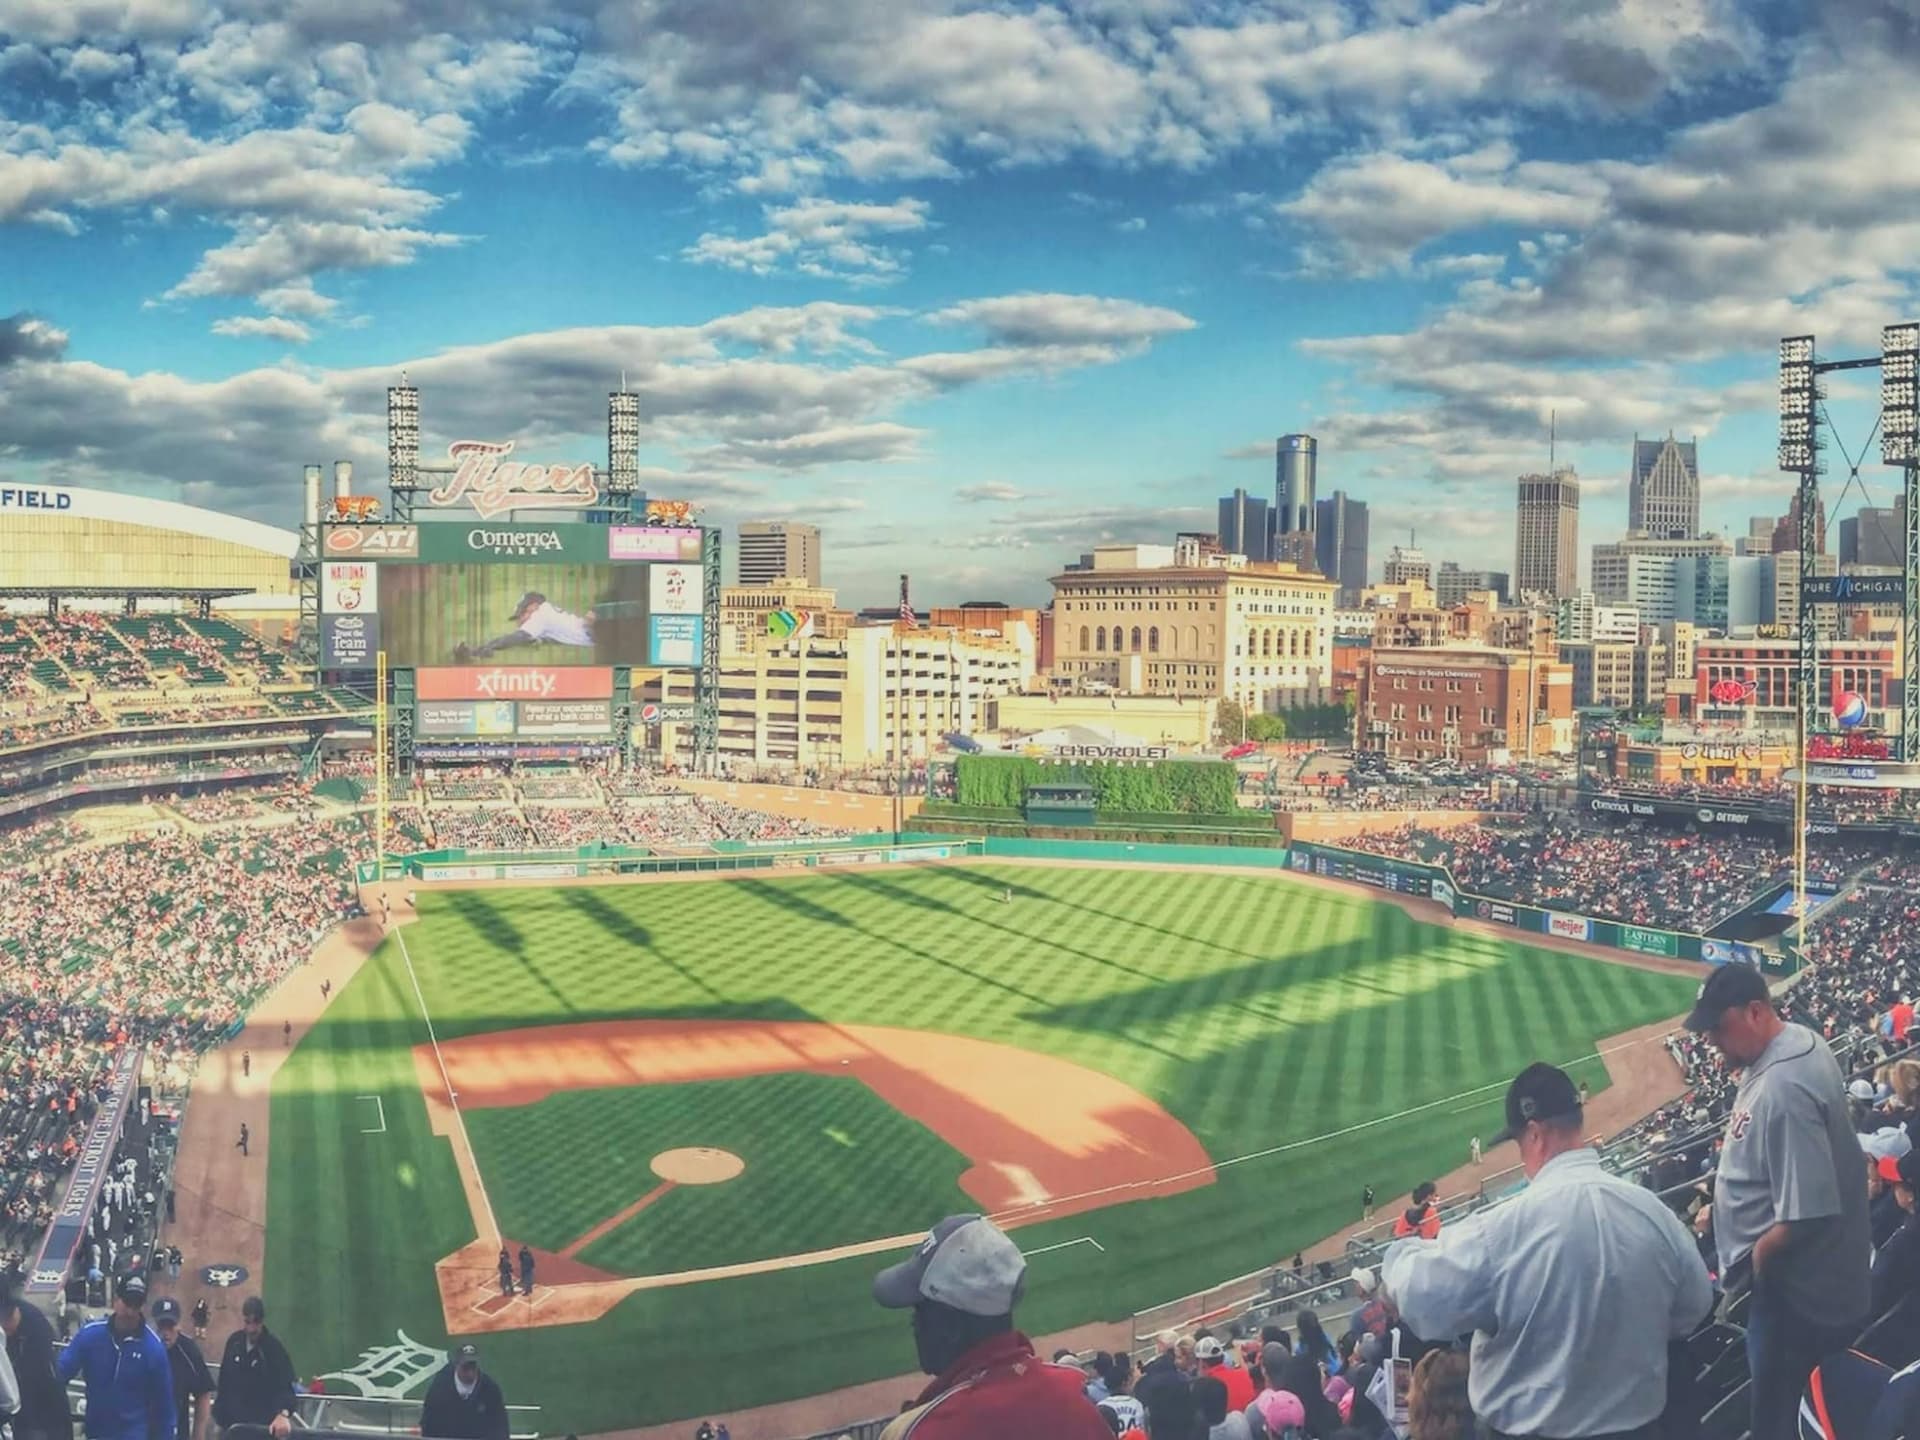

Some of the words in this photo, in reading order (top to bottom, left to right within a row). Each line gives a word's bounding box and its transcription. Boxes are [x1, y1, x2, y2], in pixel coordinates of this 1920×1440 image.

[429, 440, 598, 520] Tigers
[2, 489, 71, 509] FIELD
[362, 531, 418, 547] ATI
[1804, 583, 1831, 593] PURE
[1836, 576, 1903, 597] MICHIGAN
[332, 636, 366, 649] Team
[661, 706, 694, 719] pepsi
[1055, 745, 1169, 759] CHEVROLET
[1632, 804, 1655, 815] Bank
[1716, 812, 1750, 824] DETROIT
[1552, 919, 1585, 935] meijer
[1624, 927, 1667, 945] EASTERN
[79, 1131, 111, 1173] DETROIT
[63, 1176, 97, 1218] TIGERS
